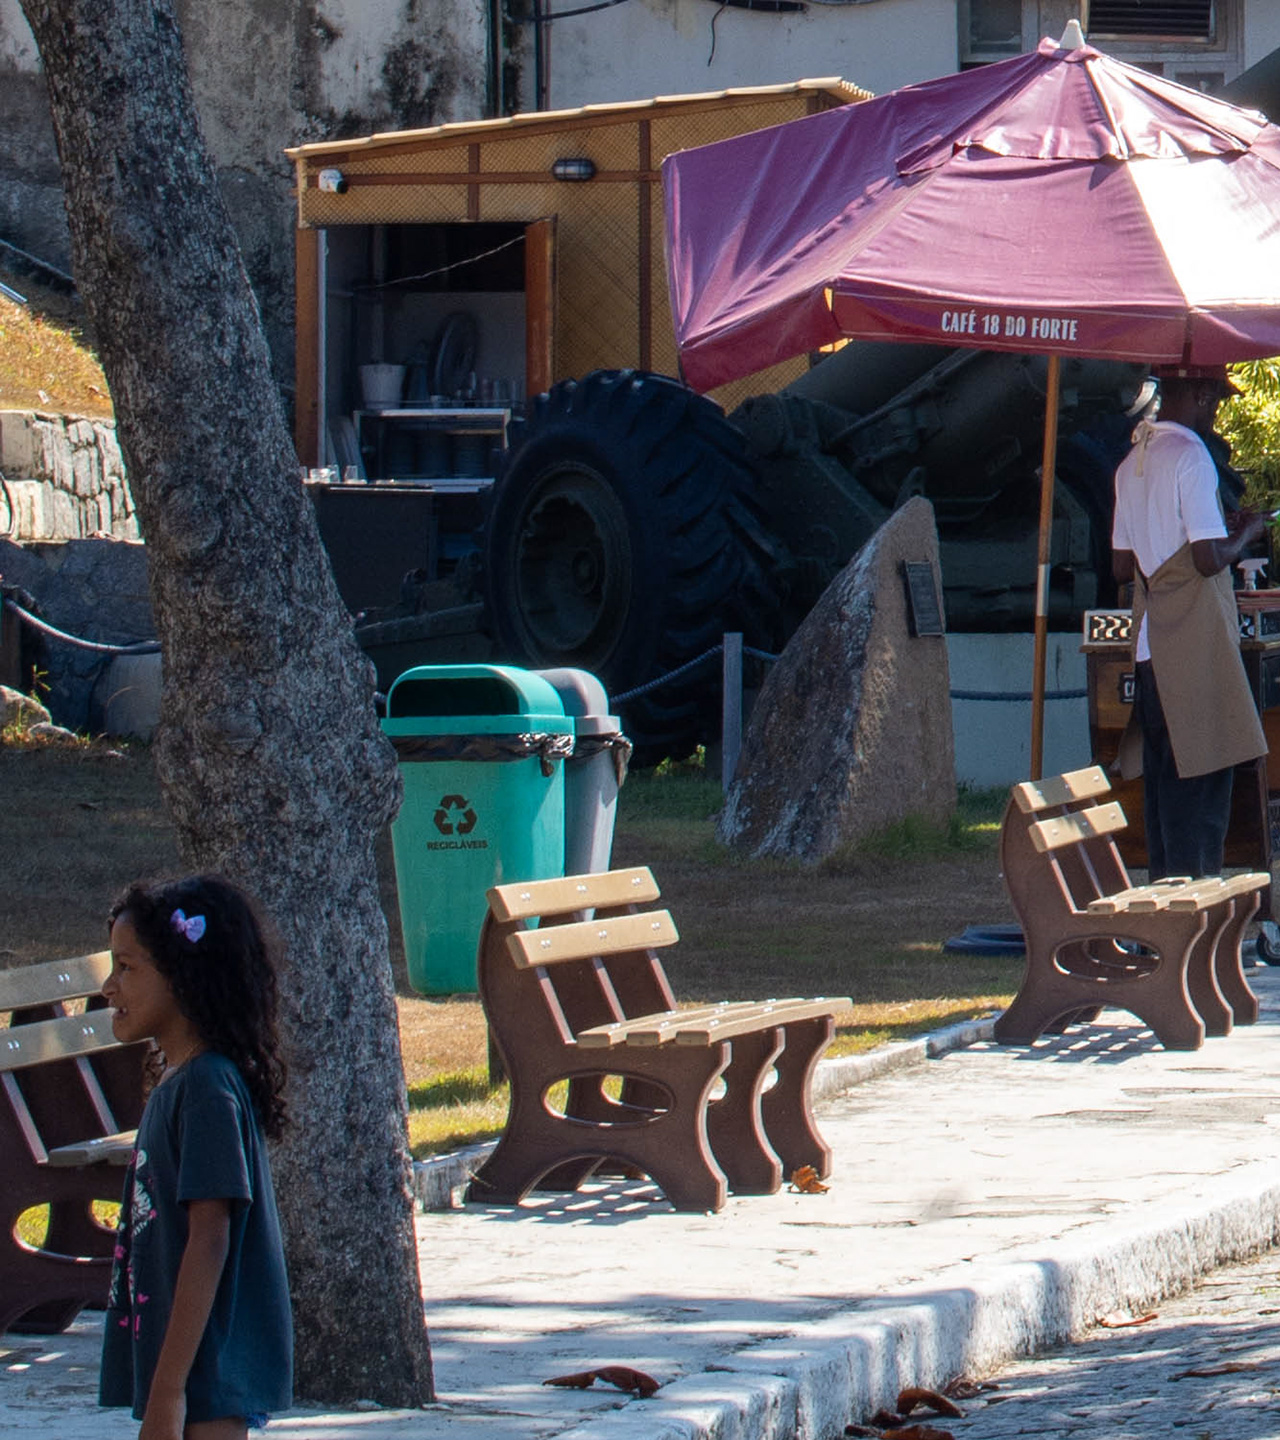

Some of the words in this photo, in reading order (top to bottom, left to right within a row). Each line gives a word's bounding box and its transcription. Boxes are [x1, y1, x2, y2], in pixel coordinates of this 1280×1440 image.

[941, 309, 977, 334] CAFÉ
[982, 314, 1001, 336] 18
[1005, 315, 1027, 338] DO
[1031, 317, 1078, 342] FORTE
[427, 839, 488, 851] RECICLÁVEIS
